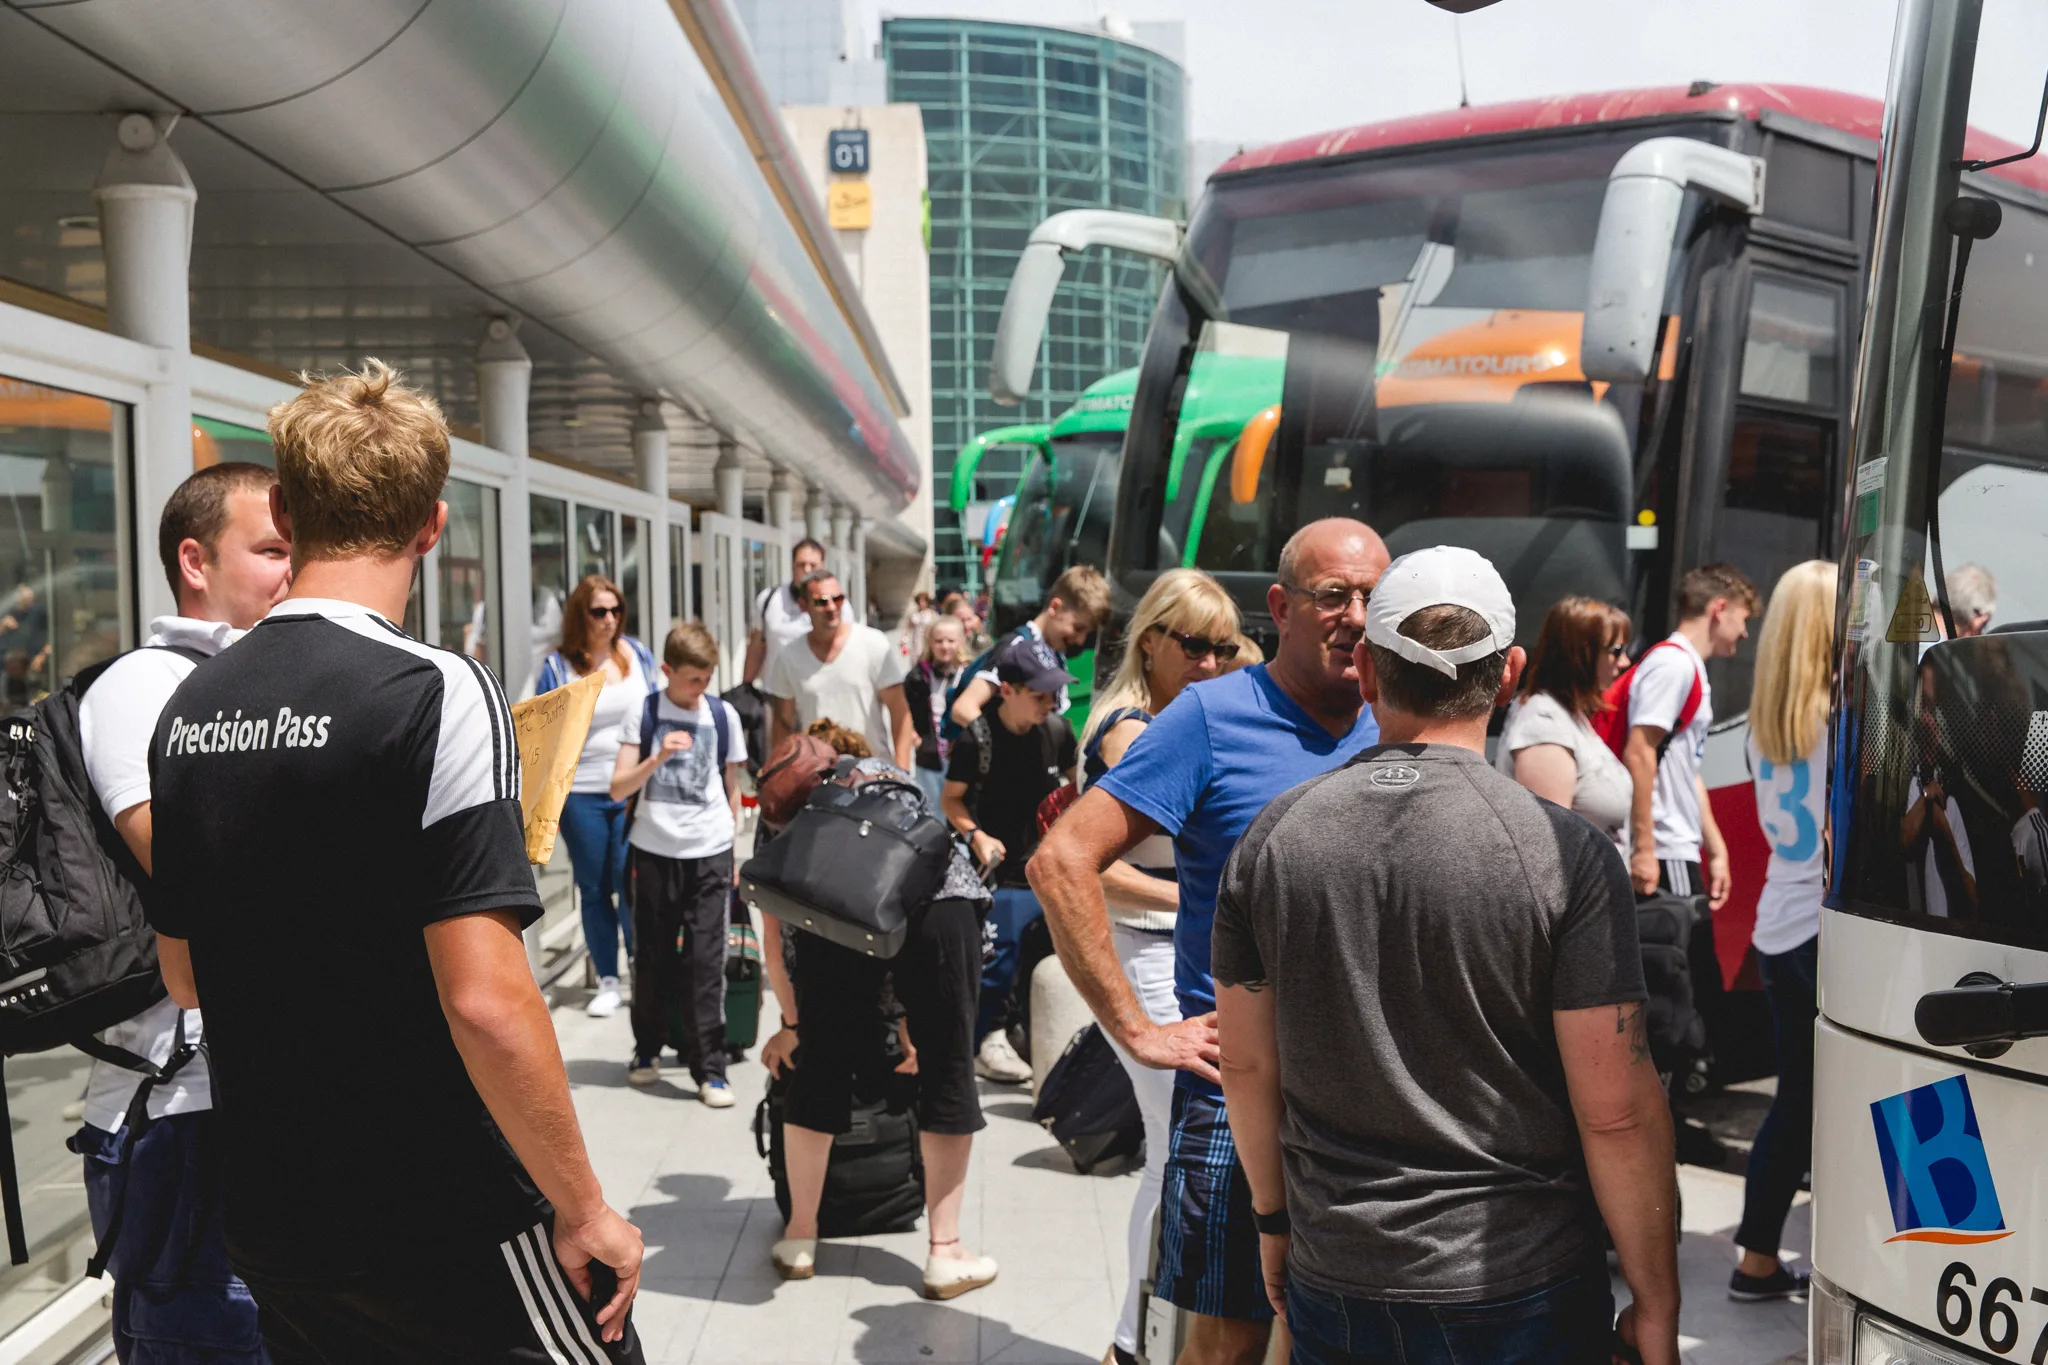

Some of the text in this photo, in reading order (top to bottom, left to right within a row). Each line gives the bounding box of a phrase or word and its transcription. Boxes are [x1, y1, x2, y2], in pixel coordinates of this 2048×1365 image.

[835, 143, 864, 168] 01
[166, 706, 332, 757] Precision Pass
[1759, 757, 1818, 862] 3
